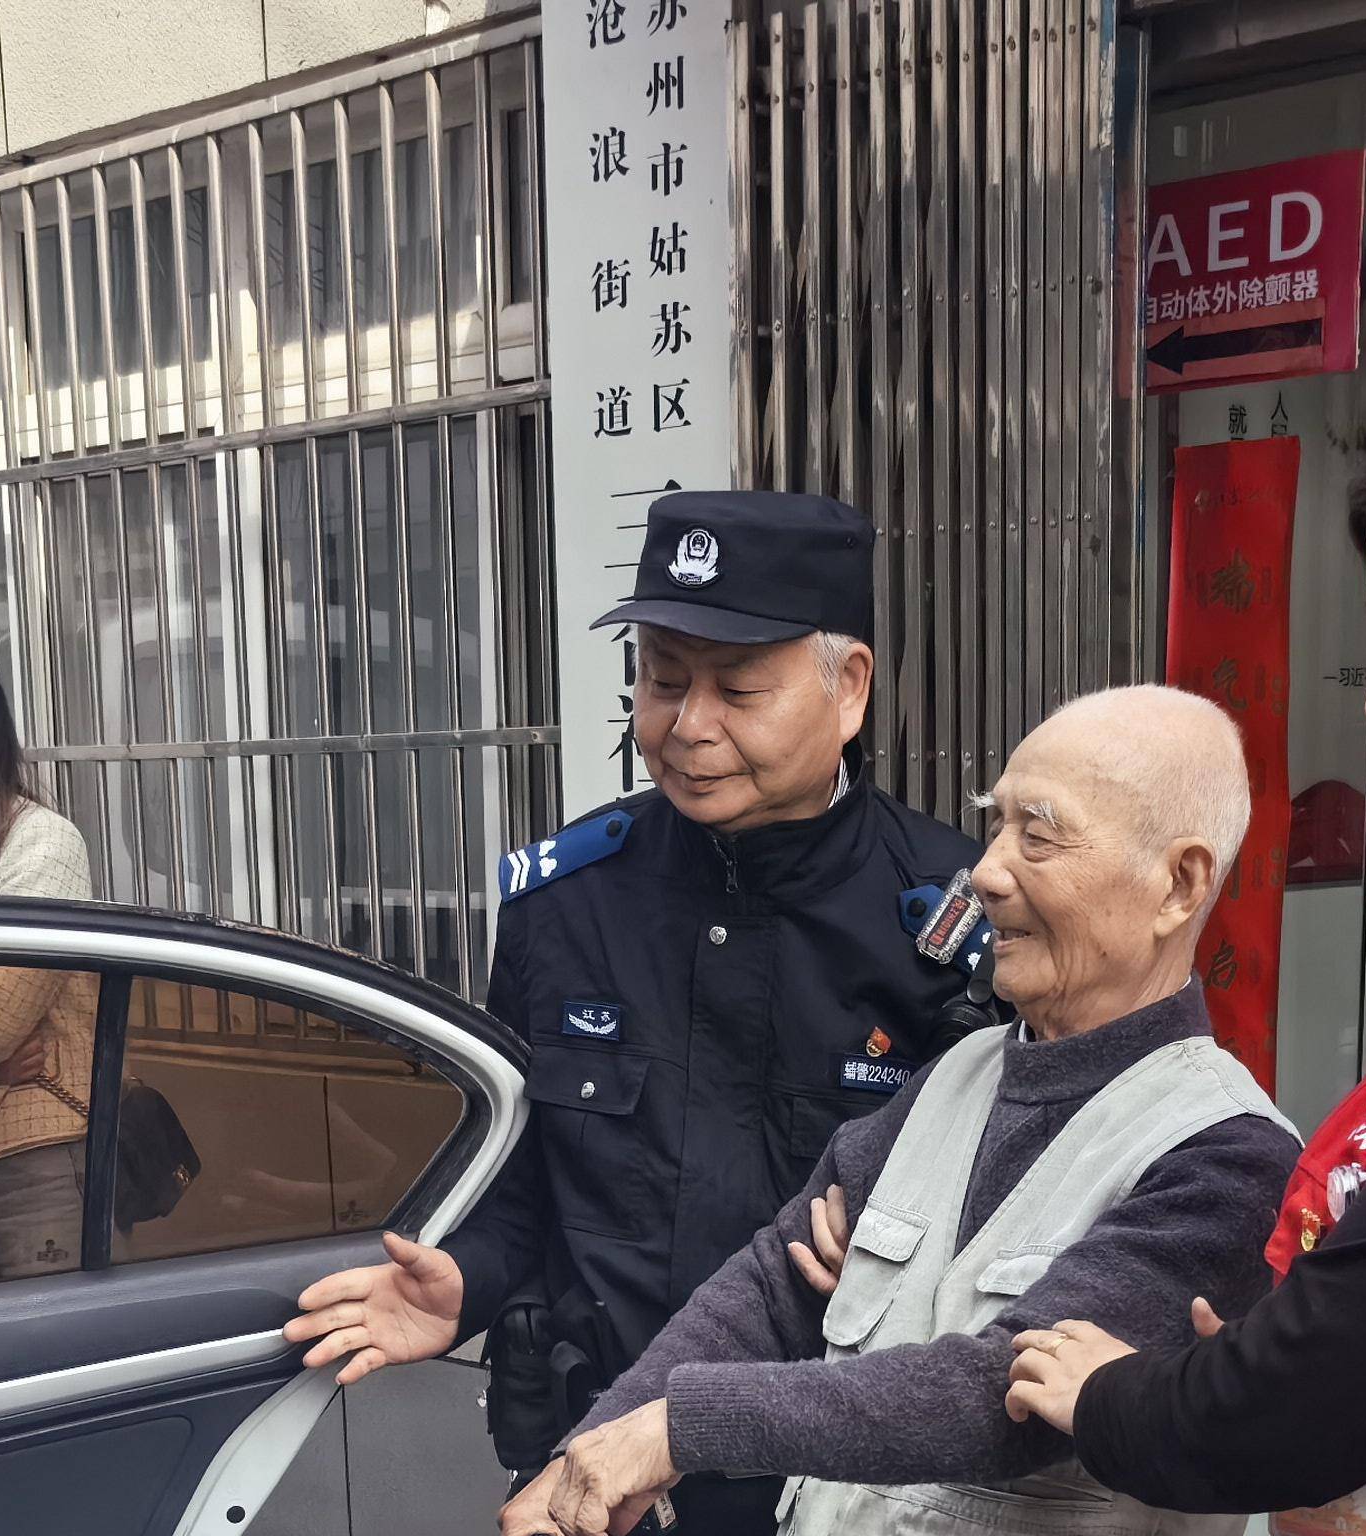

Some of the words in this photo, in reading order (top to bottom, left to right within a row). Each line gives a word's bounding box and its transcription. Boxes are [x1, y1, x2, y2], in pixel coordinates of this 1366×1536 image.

[586, 0, 633, 439] 沧浪街道
[1146, 191, 1323, 280] AED
[1145, 269, 1319, 324] 自动体外除颤器
